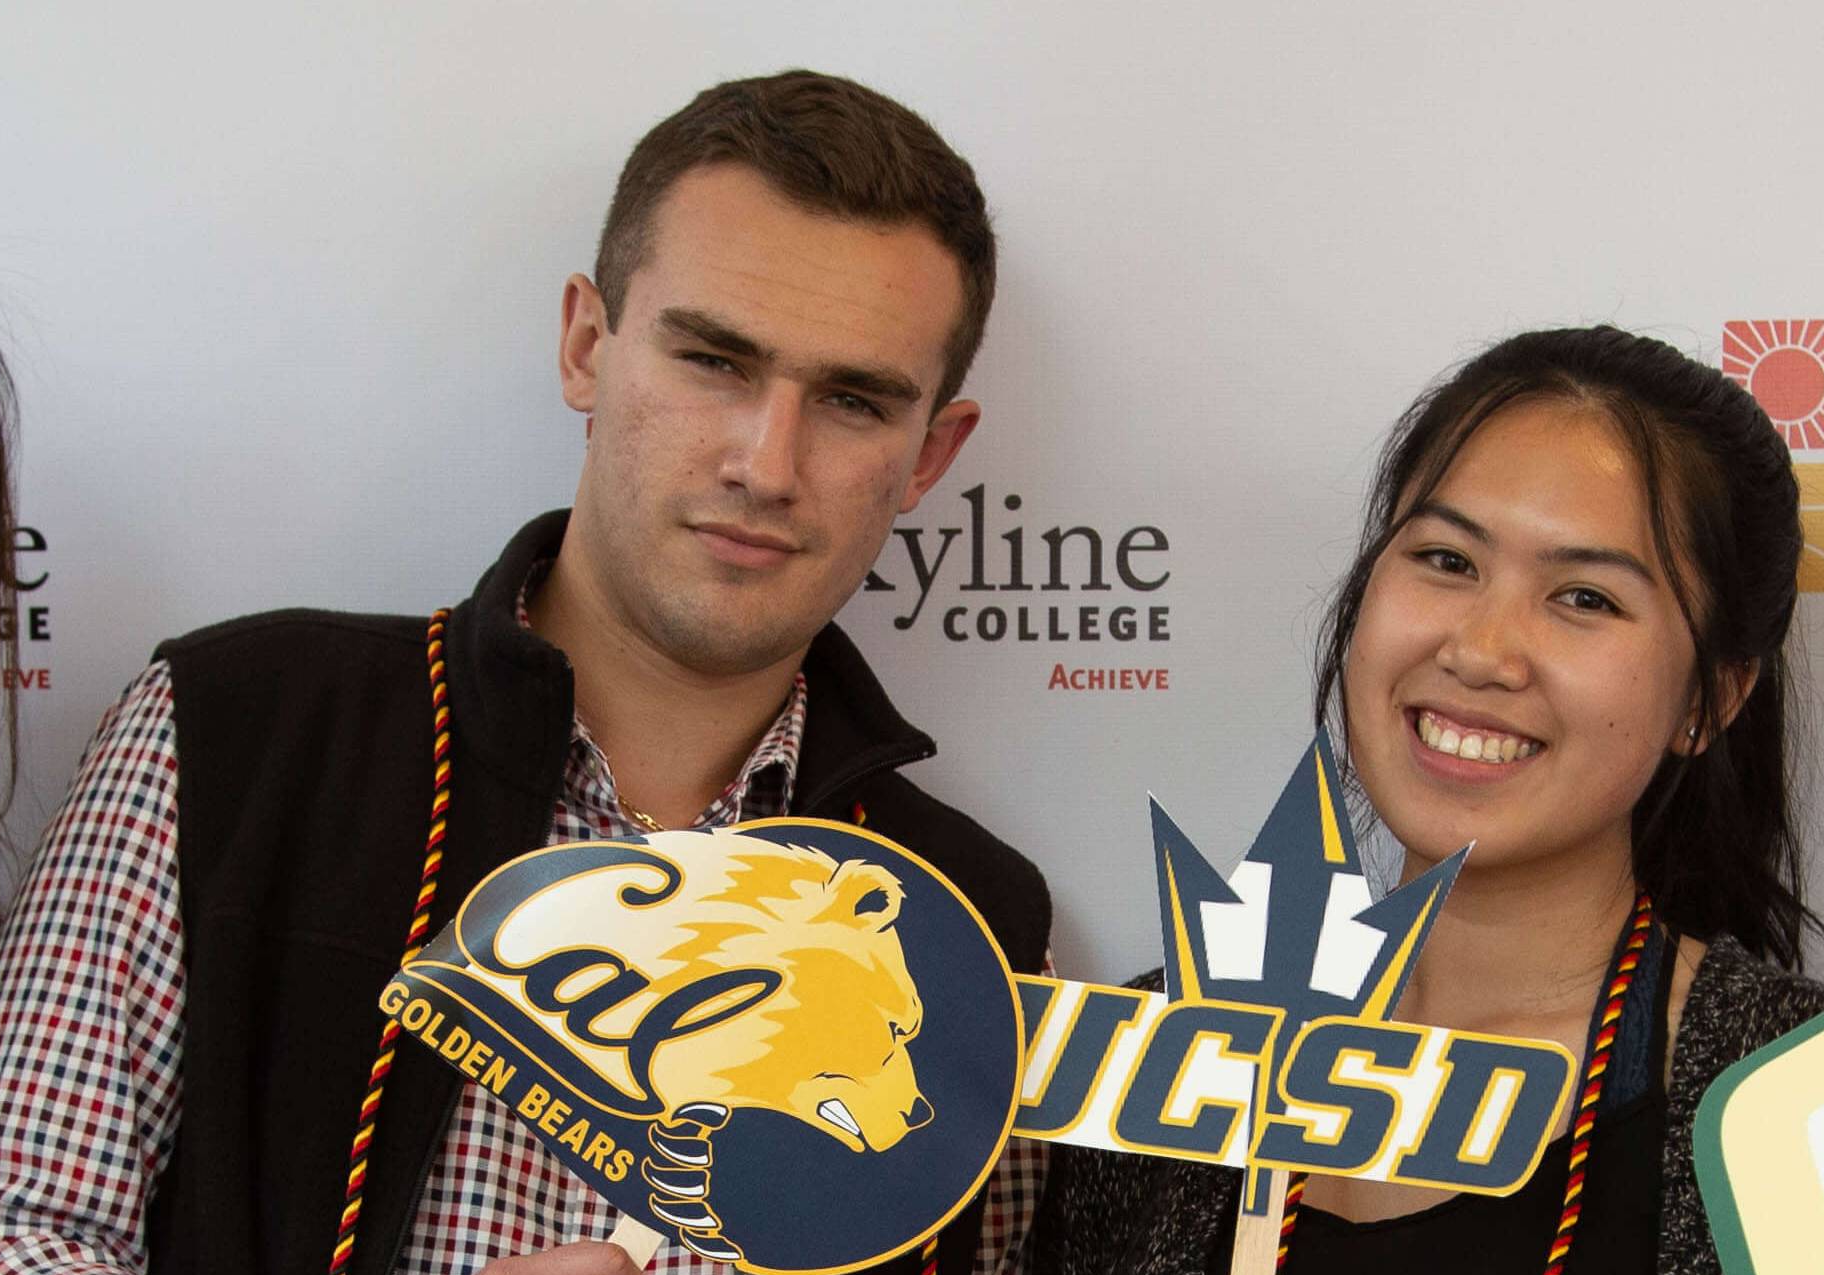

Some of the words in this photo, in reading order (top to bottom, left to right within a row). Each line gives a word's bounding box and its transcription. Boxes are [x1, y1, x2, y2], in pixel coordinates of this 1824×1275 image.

[865, 484, 1170, 630] yline
[943, 606, 1171, 642] COLLEGE
[379, 980, 519, 1095] GOLDEN
[517, 1081, 636, 1183] BEARS
[402, 840, 786, 1122] Cal
[1012, 973, 1577, 1197] UCSD
